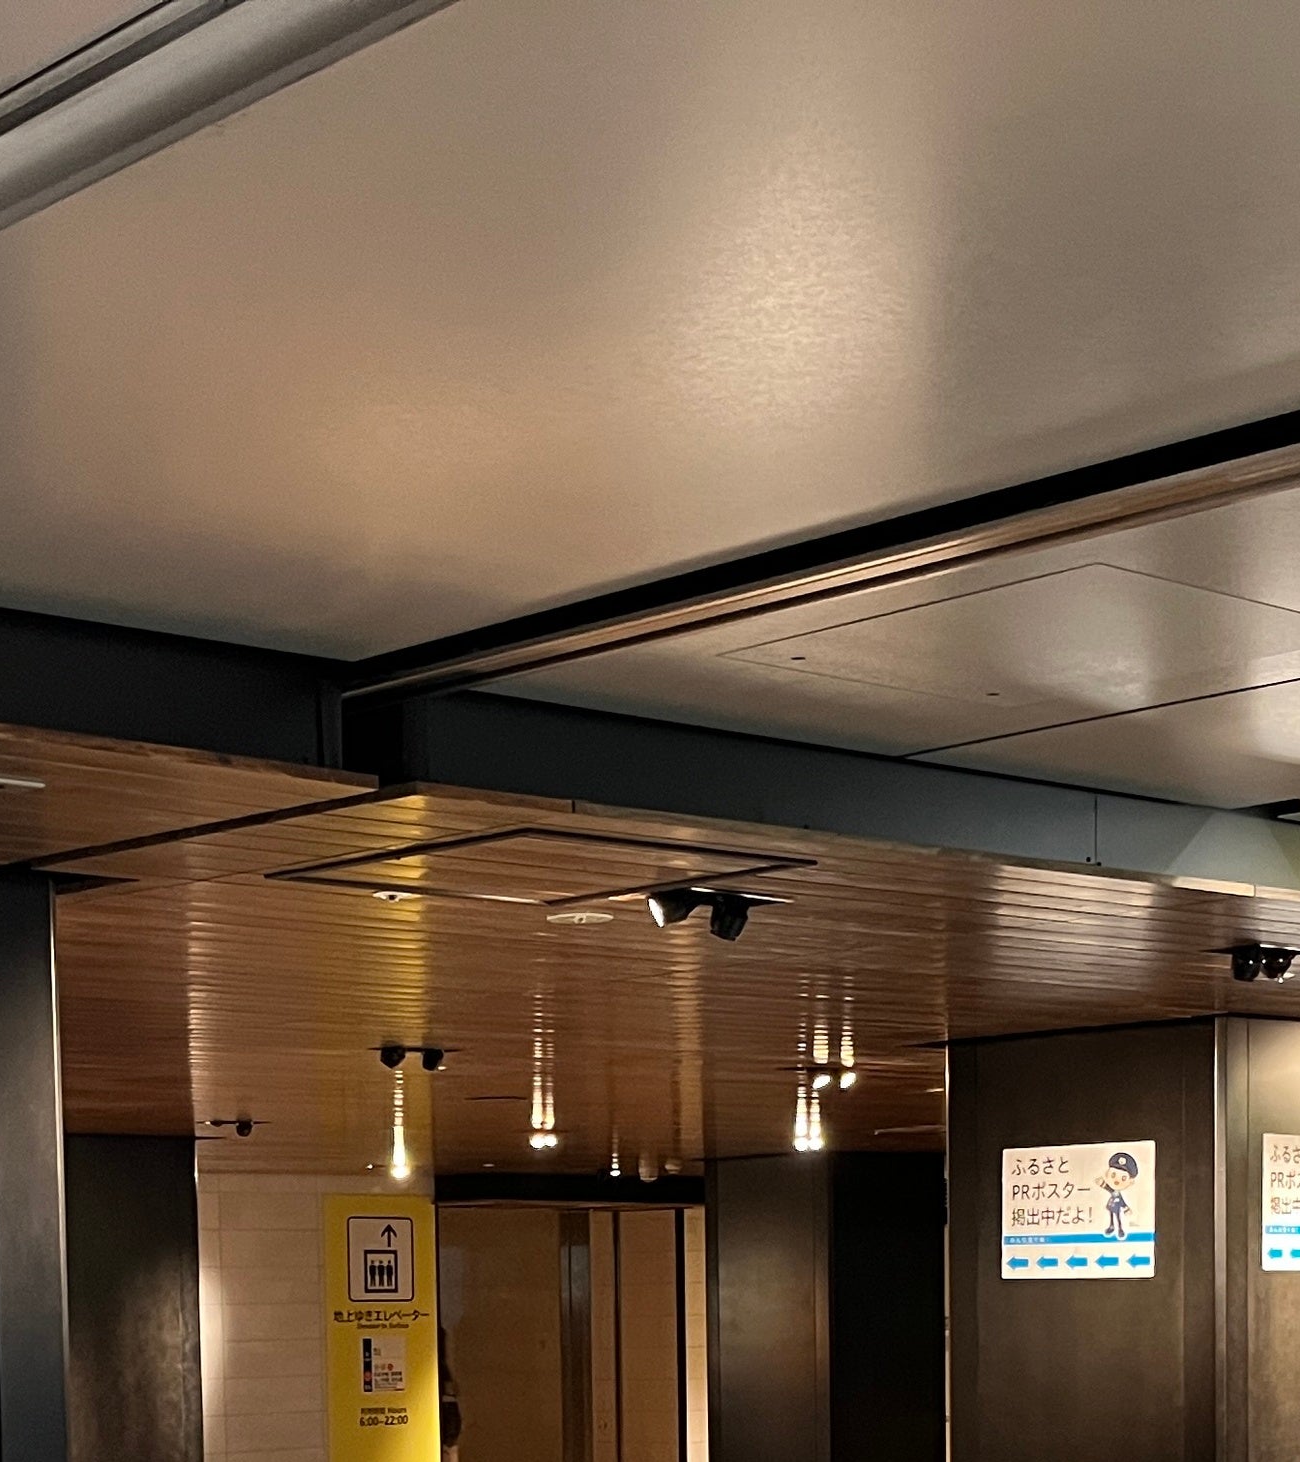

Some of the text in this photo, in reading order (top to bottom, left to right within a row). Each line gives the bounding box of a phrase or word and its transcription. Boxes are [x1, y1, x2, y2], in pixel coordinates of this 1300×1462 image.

[1011, 1156, 1070, 1176] ふるさと
[1012, 1180, 1091, 1201] PRポスター
